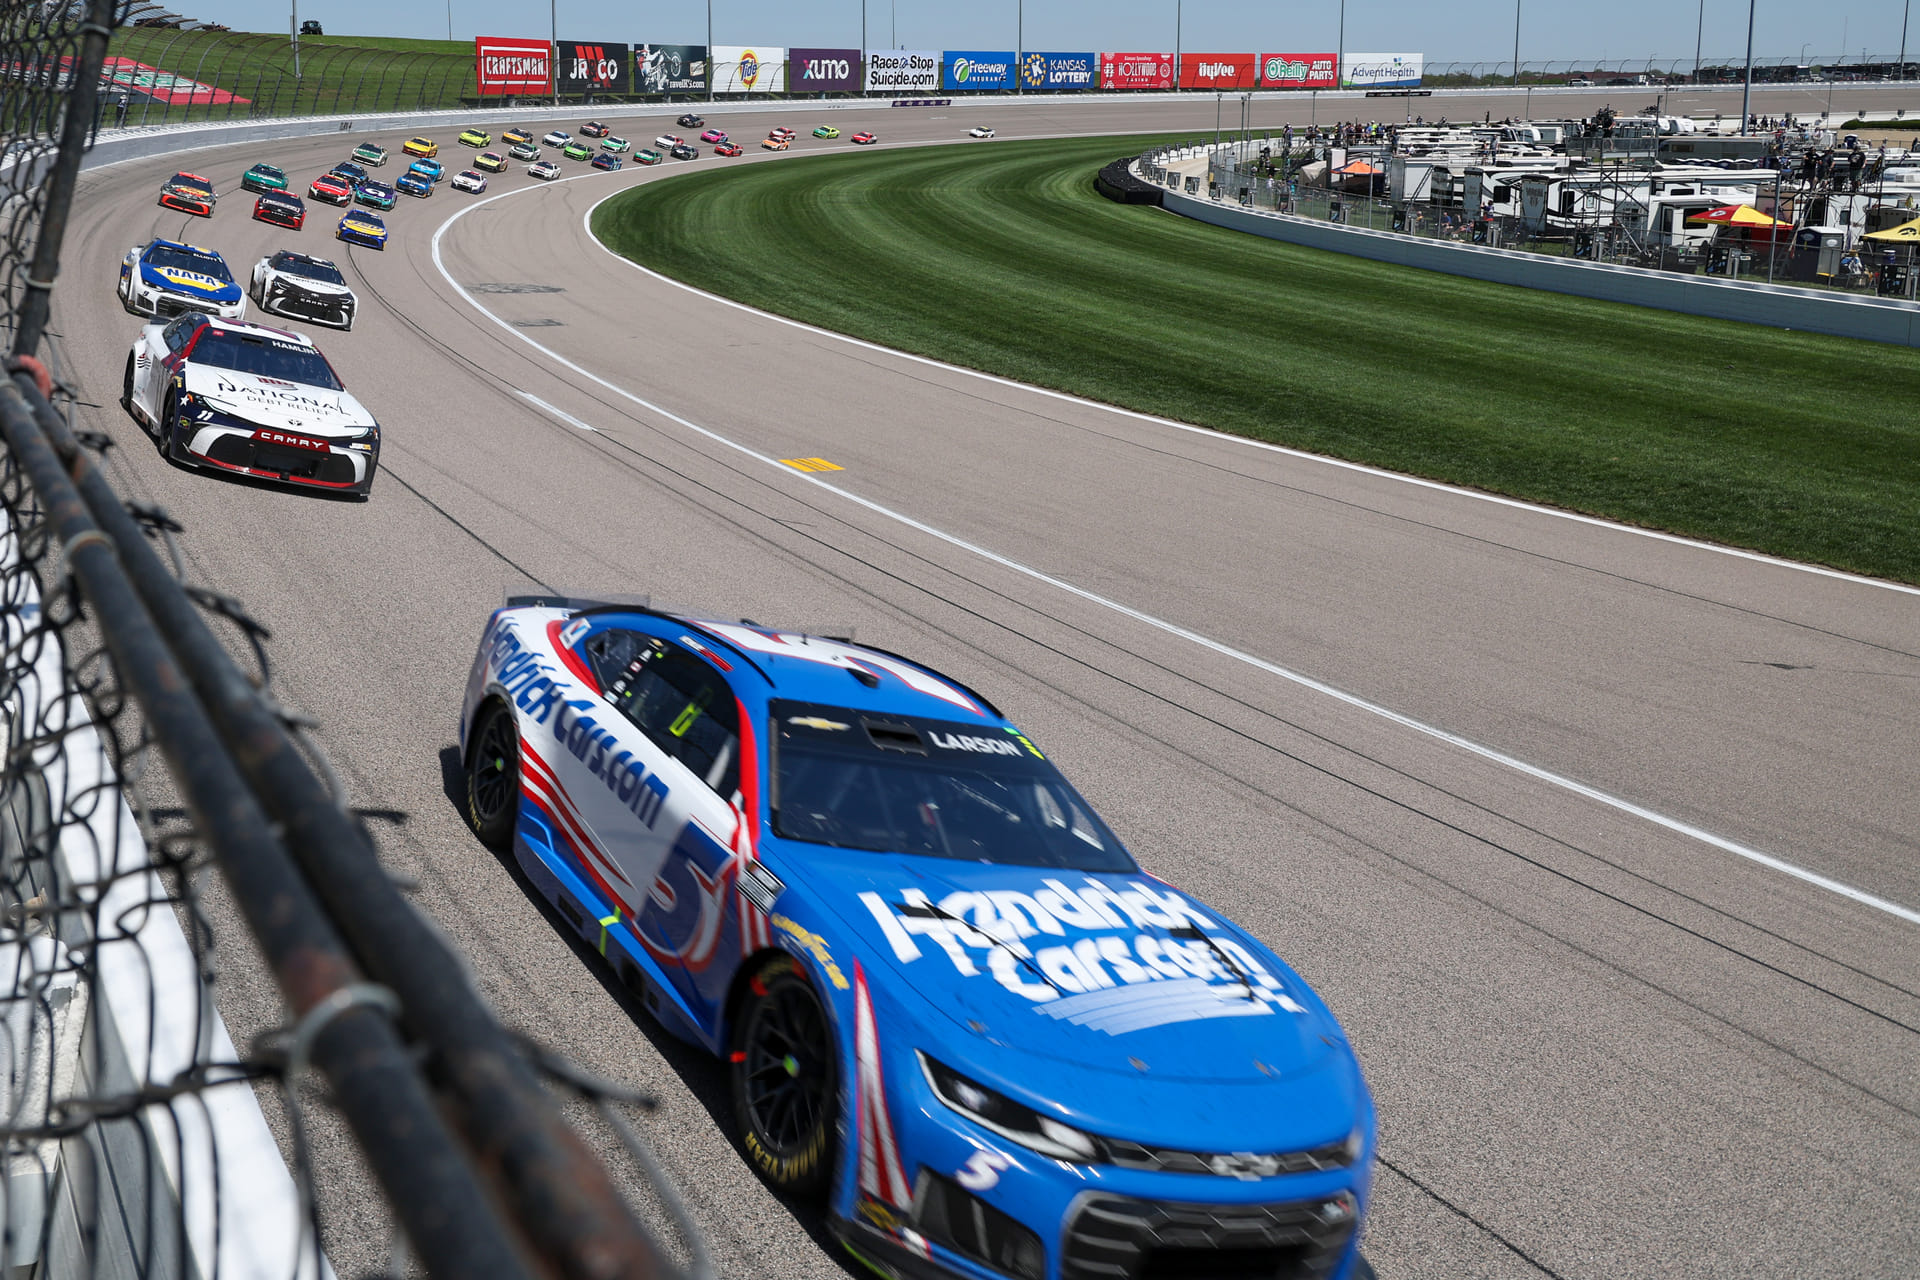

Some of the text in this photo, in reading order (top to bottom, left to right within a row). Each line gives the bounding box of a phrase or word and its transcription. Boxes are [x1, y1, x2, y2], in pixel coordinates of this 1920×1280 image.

[486, 55, 545, 76] CRAFTSMAN
[740, 59, 758, 81] Tide
[803, 59, 849, 80] xumo
[871, 54, 898, 69] Race
[910, 55, 934, 71] Stop
[969, 60, 1007, 76] Freeway
[1050, 59, 1088, 71] KANSAS
[1118, 62, 1157, 77] HOLLYWOOD
[1265, 57, 1310, 82] O'Reilly
[1311, 60, 1332, 70] AUTO
[871, 71, 935, 85] Suicide.com
[1050, 71, 1092, 83] LOTTERY
[1309, 70, 1334, 80] PARTS
[166, 267, 217, 287] NAPA
[272, 340, 315, 355] HAMLIN
[216, 372, 352, 417] NATIONAL
[247, 395, 331, 416] DEBT RELIEF
[197, 410, 214, 421] 11
[260, 431, 325, 449] CAMRY
[928, 730, 1024, 757] LARSON
[857, 877, 1219, 977] Hendrick
[987, 934, 1309, 1013] Cars.com
[954, 1150, 1010, 1191] 5
